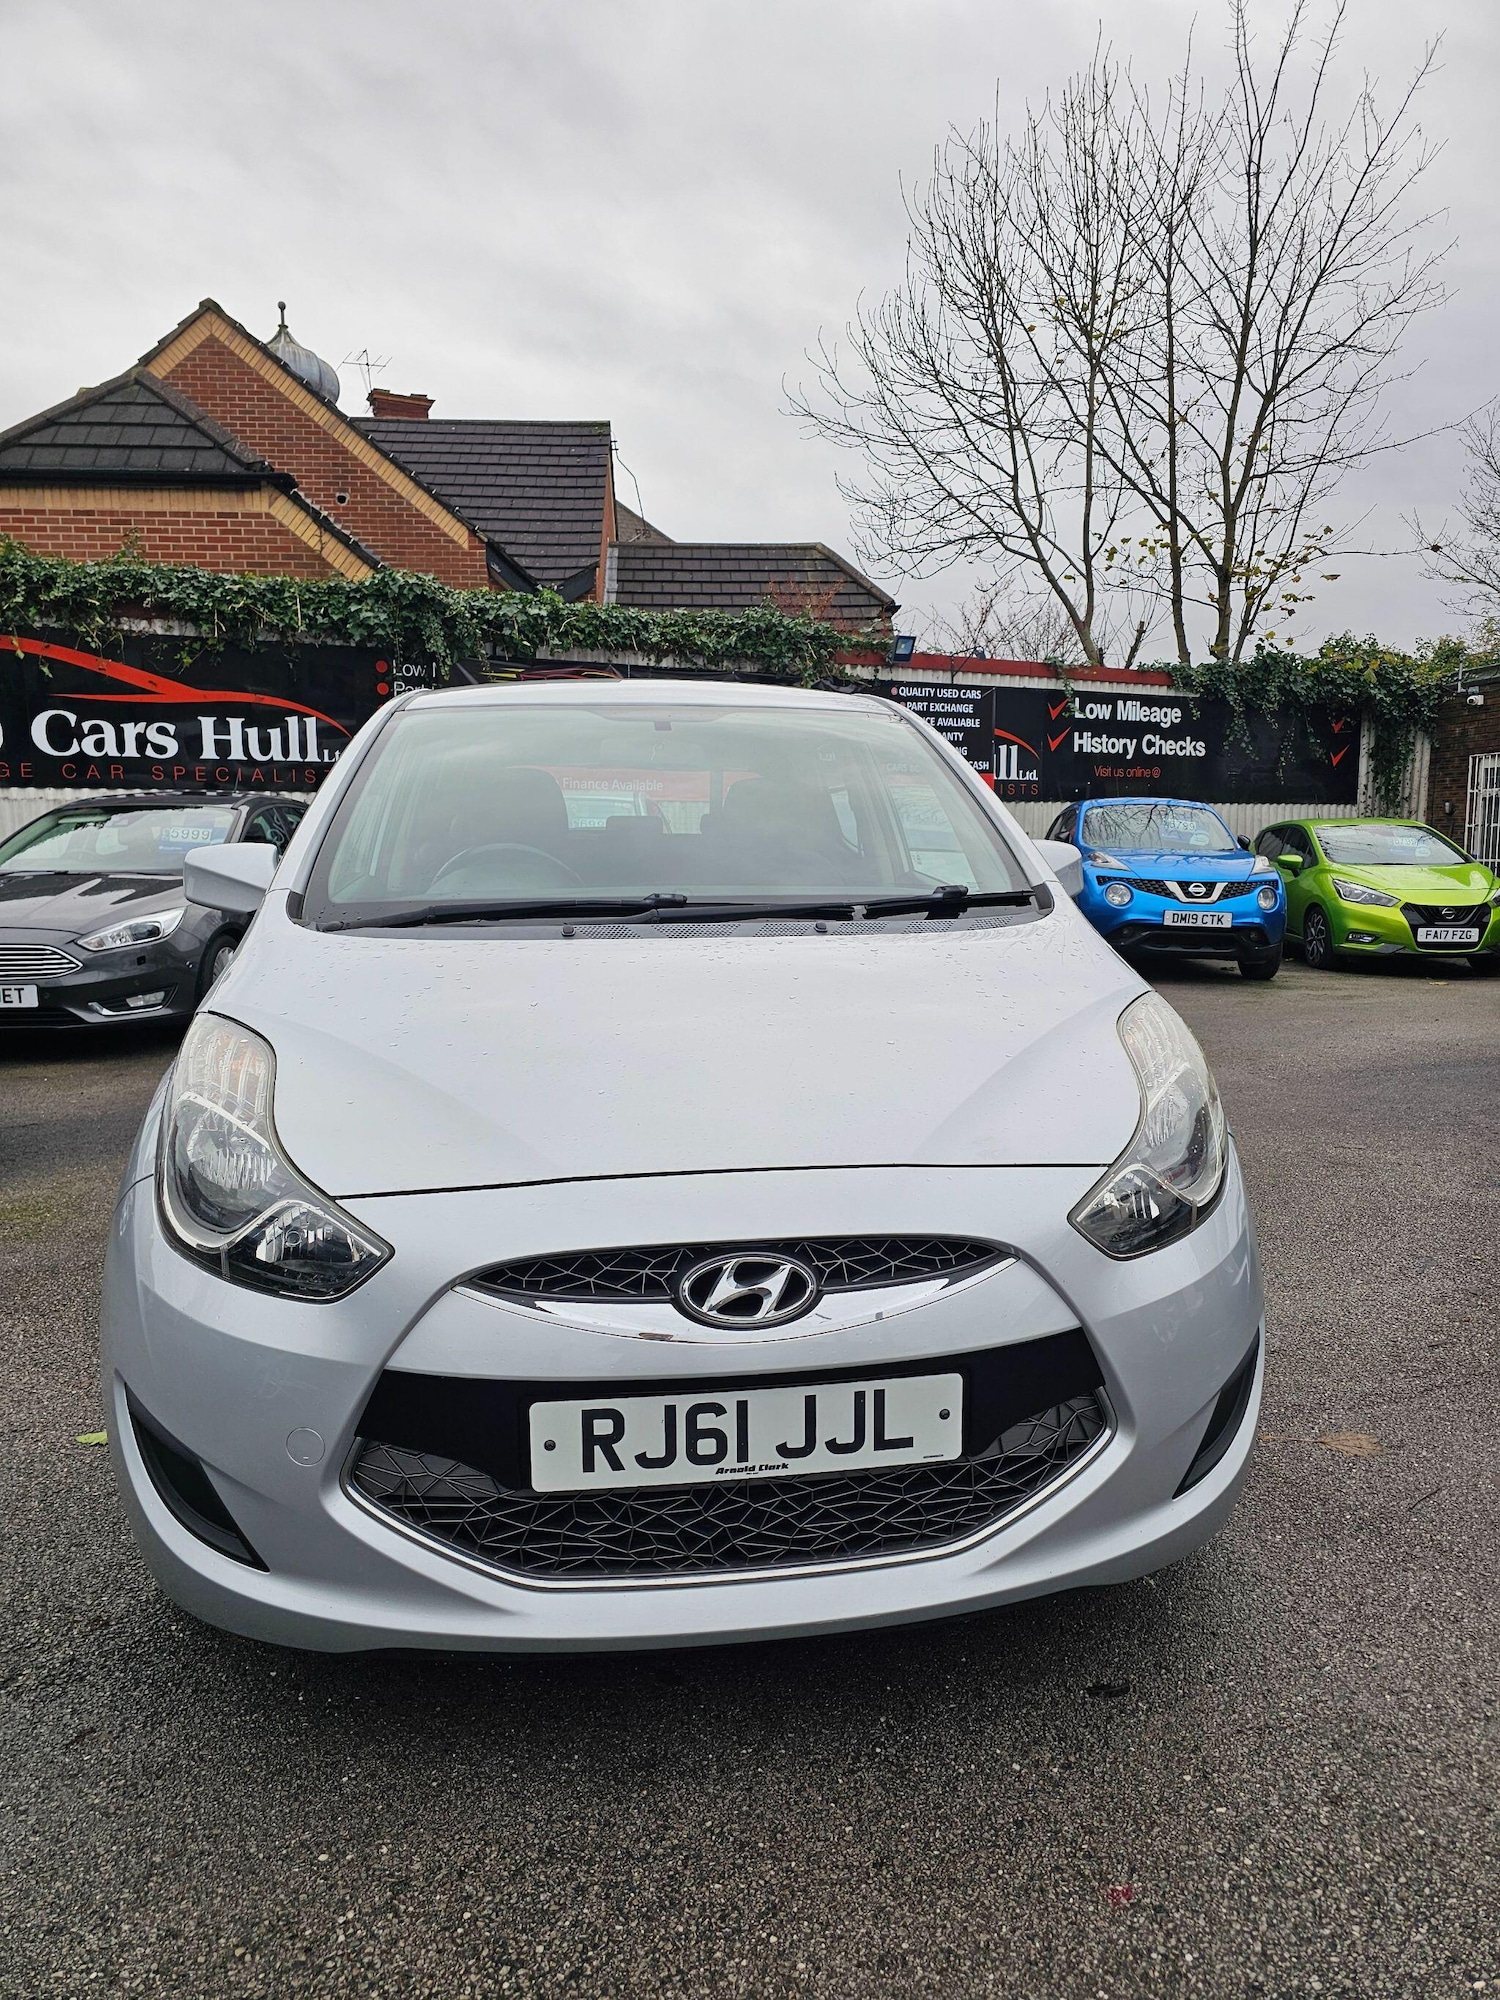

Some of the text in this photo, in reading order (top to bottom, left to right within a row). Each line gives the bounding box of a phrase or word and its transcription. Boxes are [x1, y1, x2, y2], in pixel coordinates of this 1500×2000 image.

[898, 686, 982, 700] QUALITY USED CARS
[906, 701, 974, 713] PART EXCHANGE
[1074, 697, 1182, 729] Low Mileage
[937, 717, 981, 728] AVALIABLE
[31, 709, 179, 759] Cars
[197, 715, 321, 763] Hull
[323, 749, 341, 763] Lt
[1073, 731, 1207, 760] History Checks
[62, 764, 124, 780] CAR
[1019, 769, 1039, 781] Ltd.
[1094, 765, 1112, 778] Visit
[1113, 767, 1125, 778] us
[1126, 766, 1151, 778] online
[562, 777, 664, 792] Finance Available
[1171, 912, 1225, 926] DM19 CTK
[1425, 929, 1472, 940] FA17 FZG
[1, 987, 25, 1004] ET
[581, 1389, 914, 1473] RJ61 JJL
[715, 1462, 790, 1475] Arnold Clark
